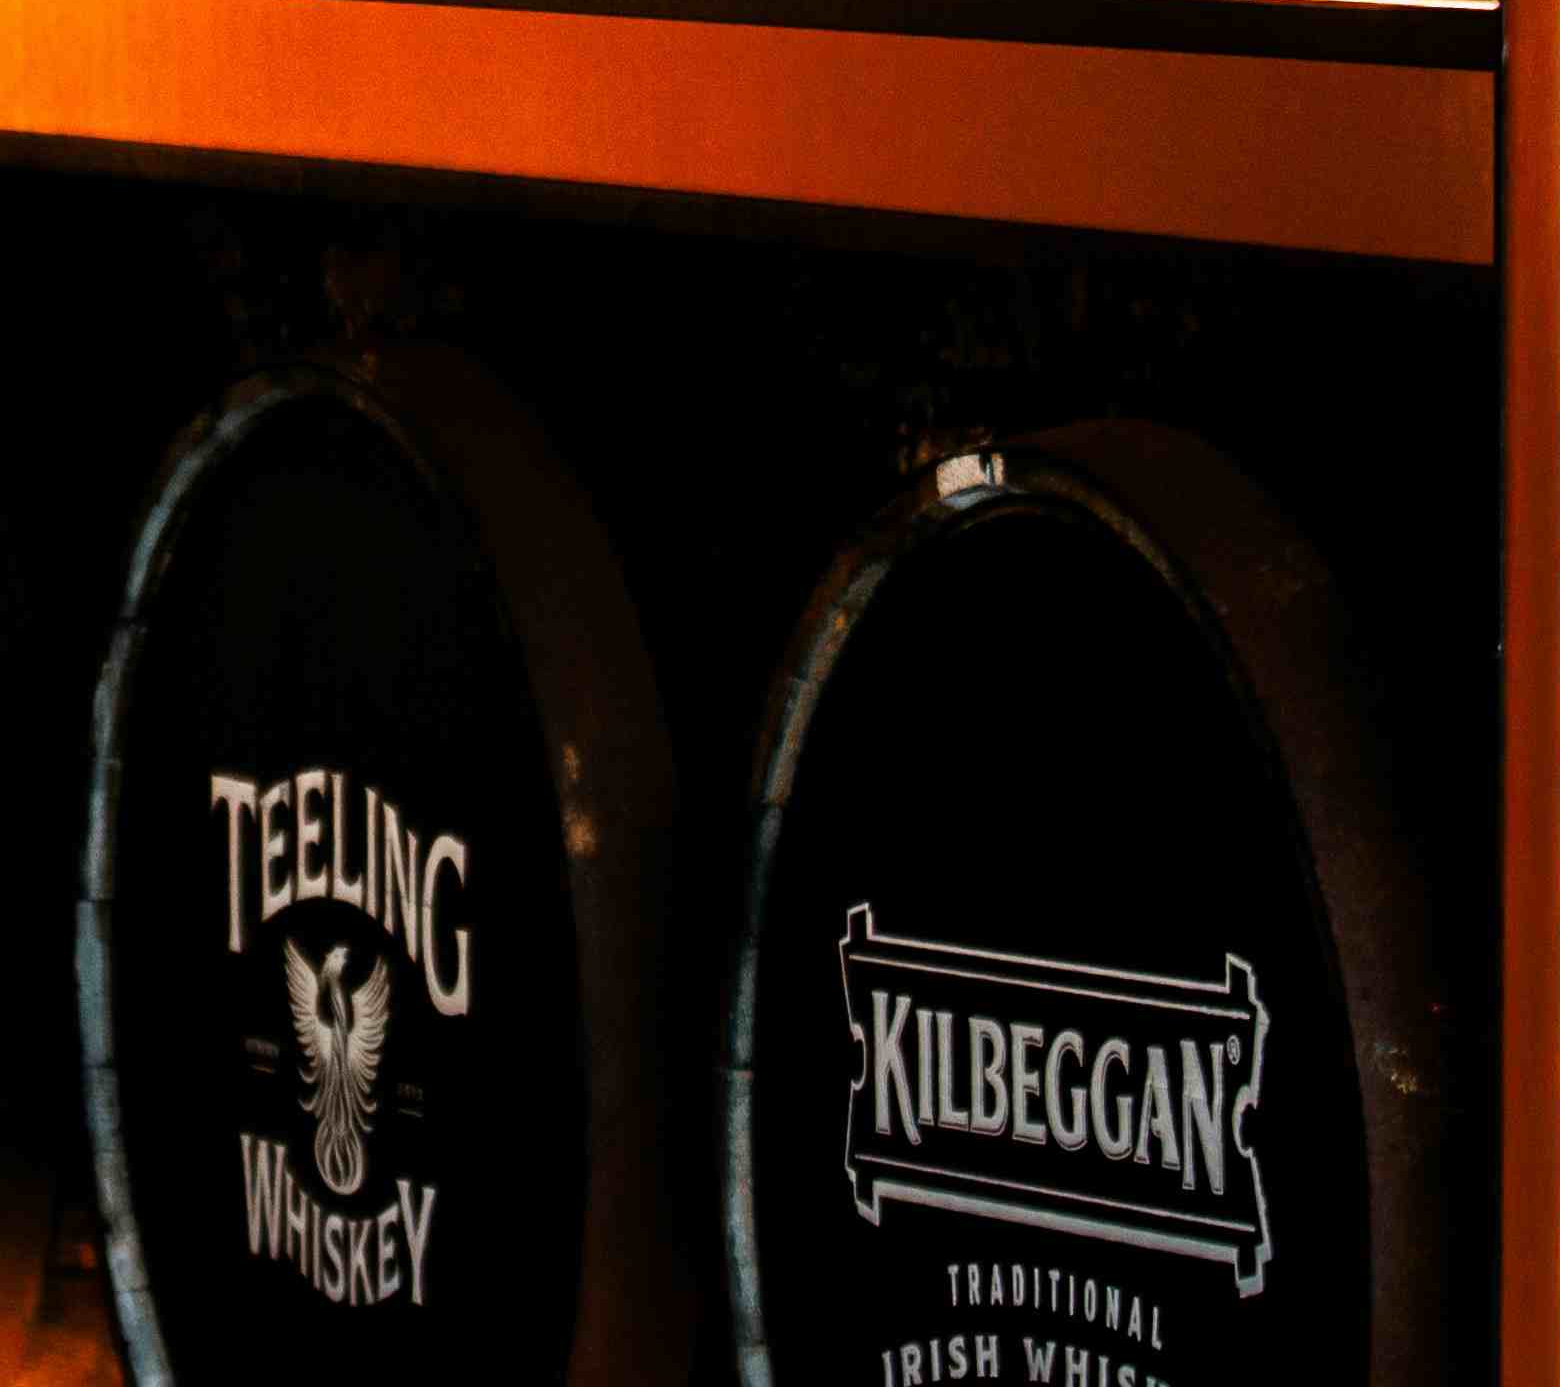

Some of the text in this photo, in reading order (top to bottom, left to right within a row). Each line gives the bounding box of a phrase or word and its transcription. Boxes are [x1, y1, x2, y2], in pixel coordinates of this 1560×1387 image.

[209, 765, 472, 1018] TEELING
[870, 988, 1226, 1196] KILBEGGAN
[238, 1129, 438, 1308] WHISKEY
[946, 1262, 1164, 1351] TRADITIONAL
[881, 1334, 1173, 1387] IRISH WHIS
